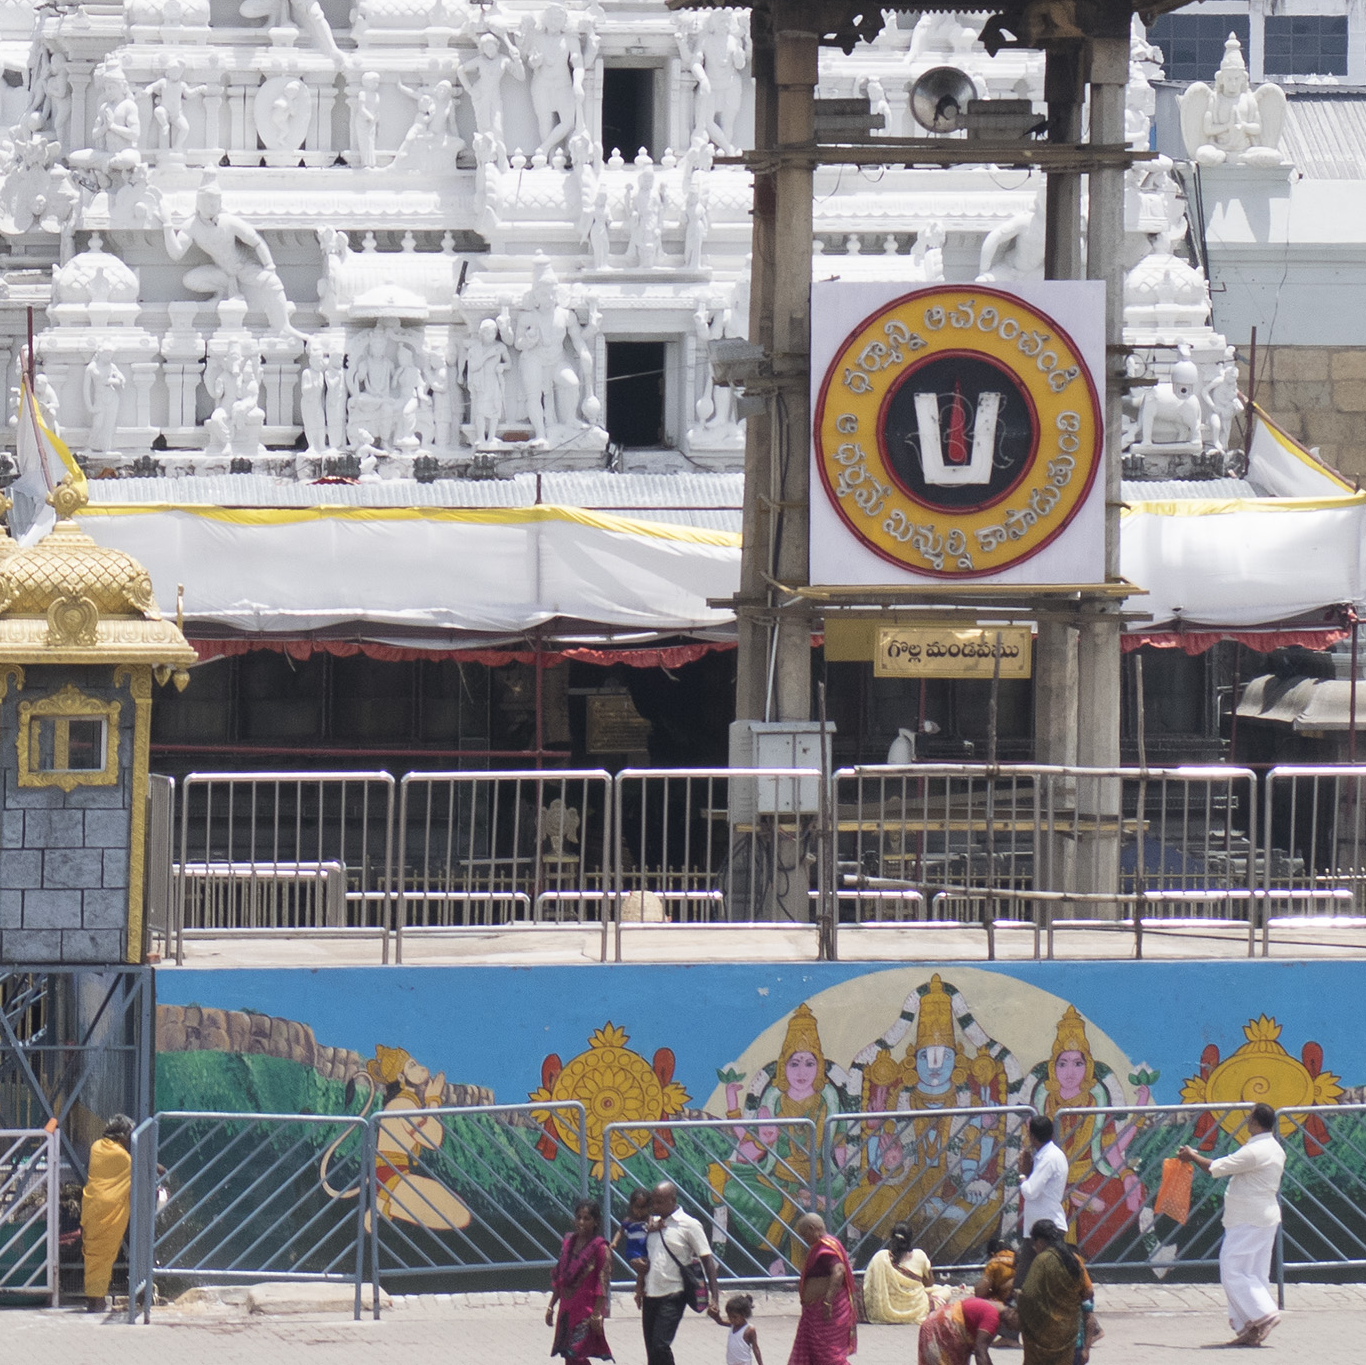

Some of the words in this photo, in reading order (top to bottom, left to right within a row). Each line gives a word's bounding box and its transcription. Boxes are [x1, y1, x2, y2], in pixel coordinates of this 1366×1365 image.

[843, 319, 928, 394] ధర్మాన్ని
[924, 299, 1080, 393] ఆచరించండి
[976, 410, 1081, 553] కాపాడుతుంది
[887, 639, 922, 663] గొల్ల
